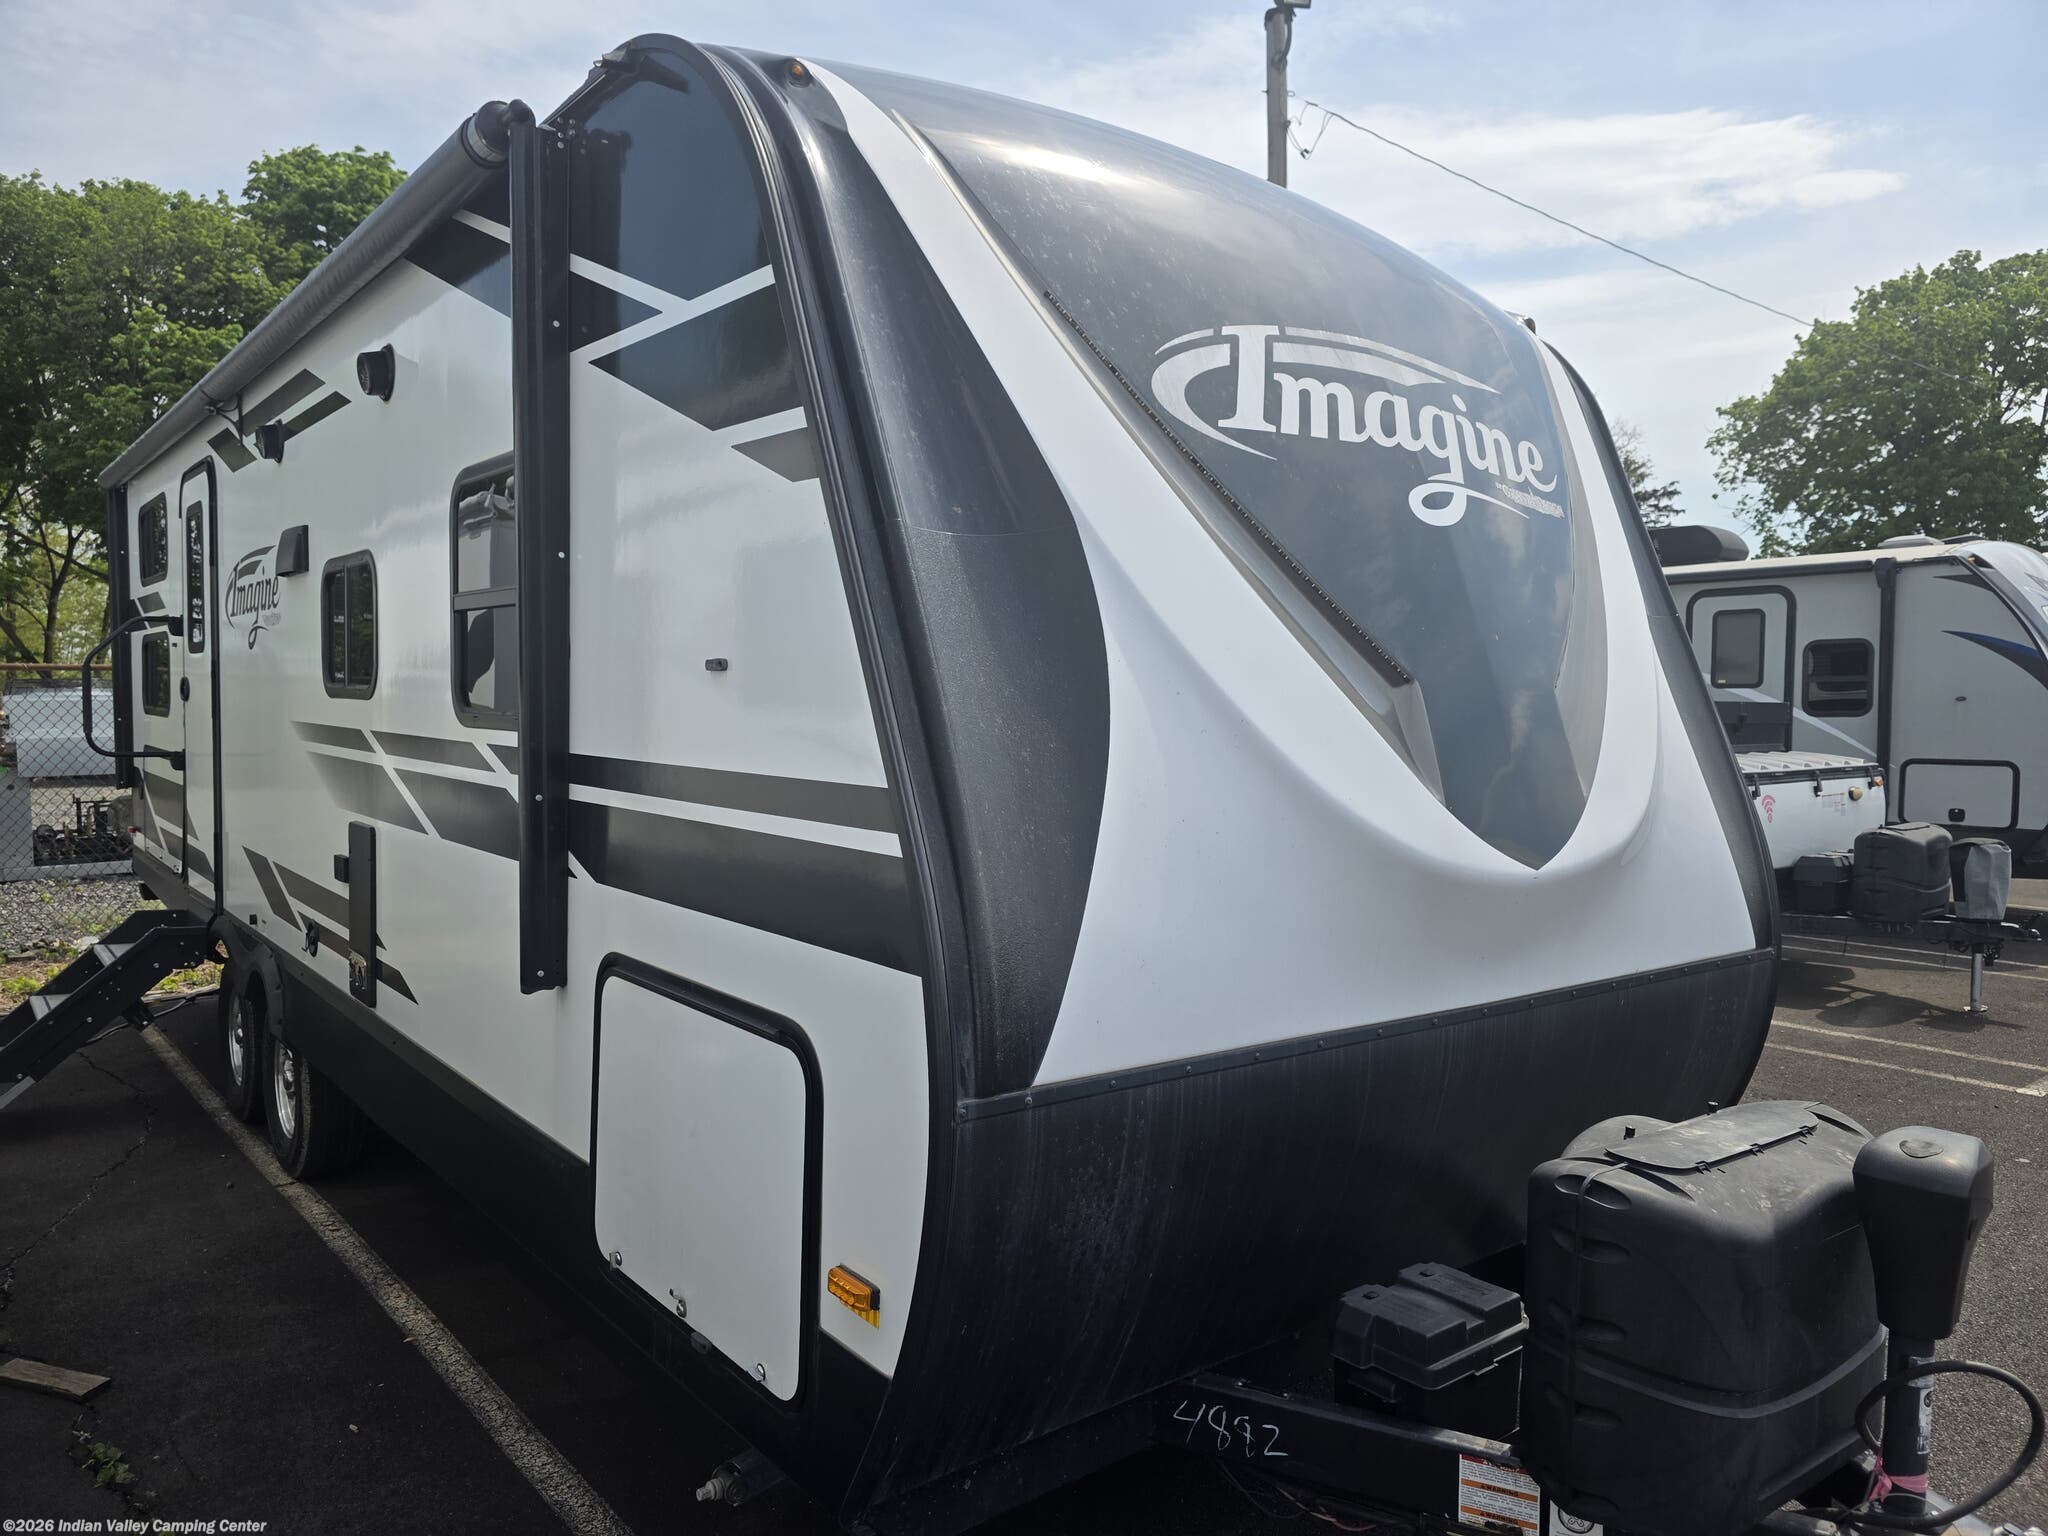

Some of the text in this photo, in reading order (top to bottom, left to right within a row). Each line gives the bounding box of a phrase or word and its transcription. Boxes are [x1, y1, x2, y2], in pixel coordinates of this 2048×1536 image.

[1217, 324, 1558, 527] Imagine
[230, 561, 281, 650] Imagine
[1173, 1400, 1288, 1457] 4882
[1486, 1485, 1519, 1497] WARNING
[1486, 1513, 1519, 1525] WARNING
